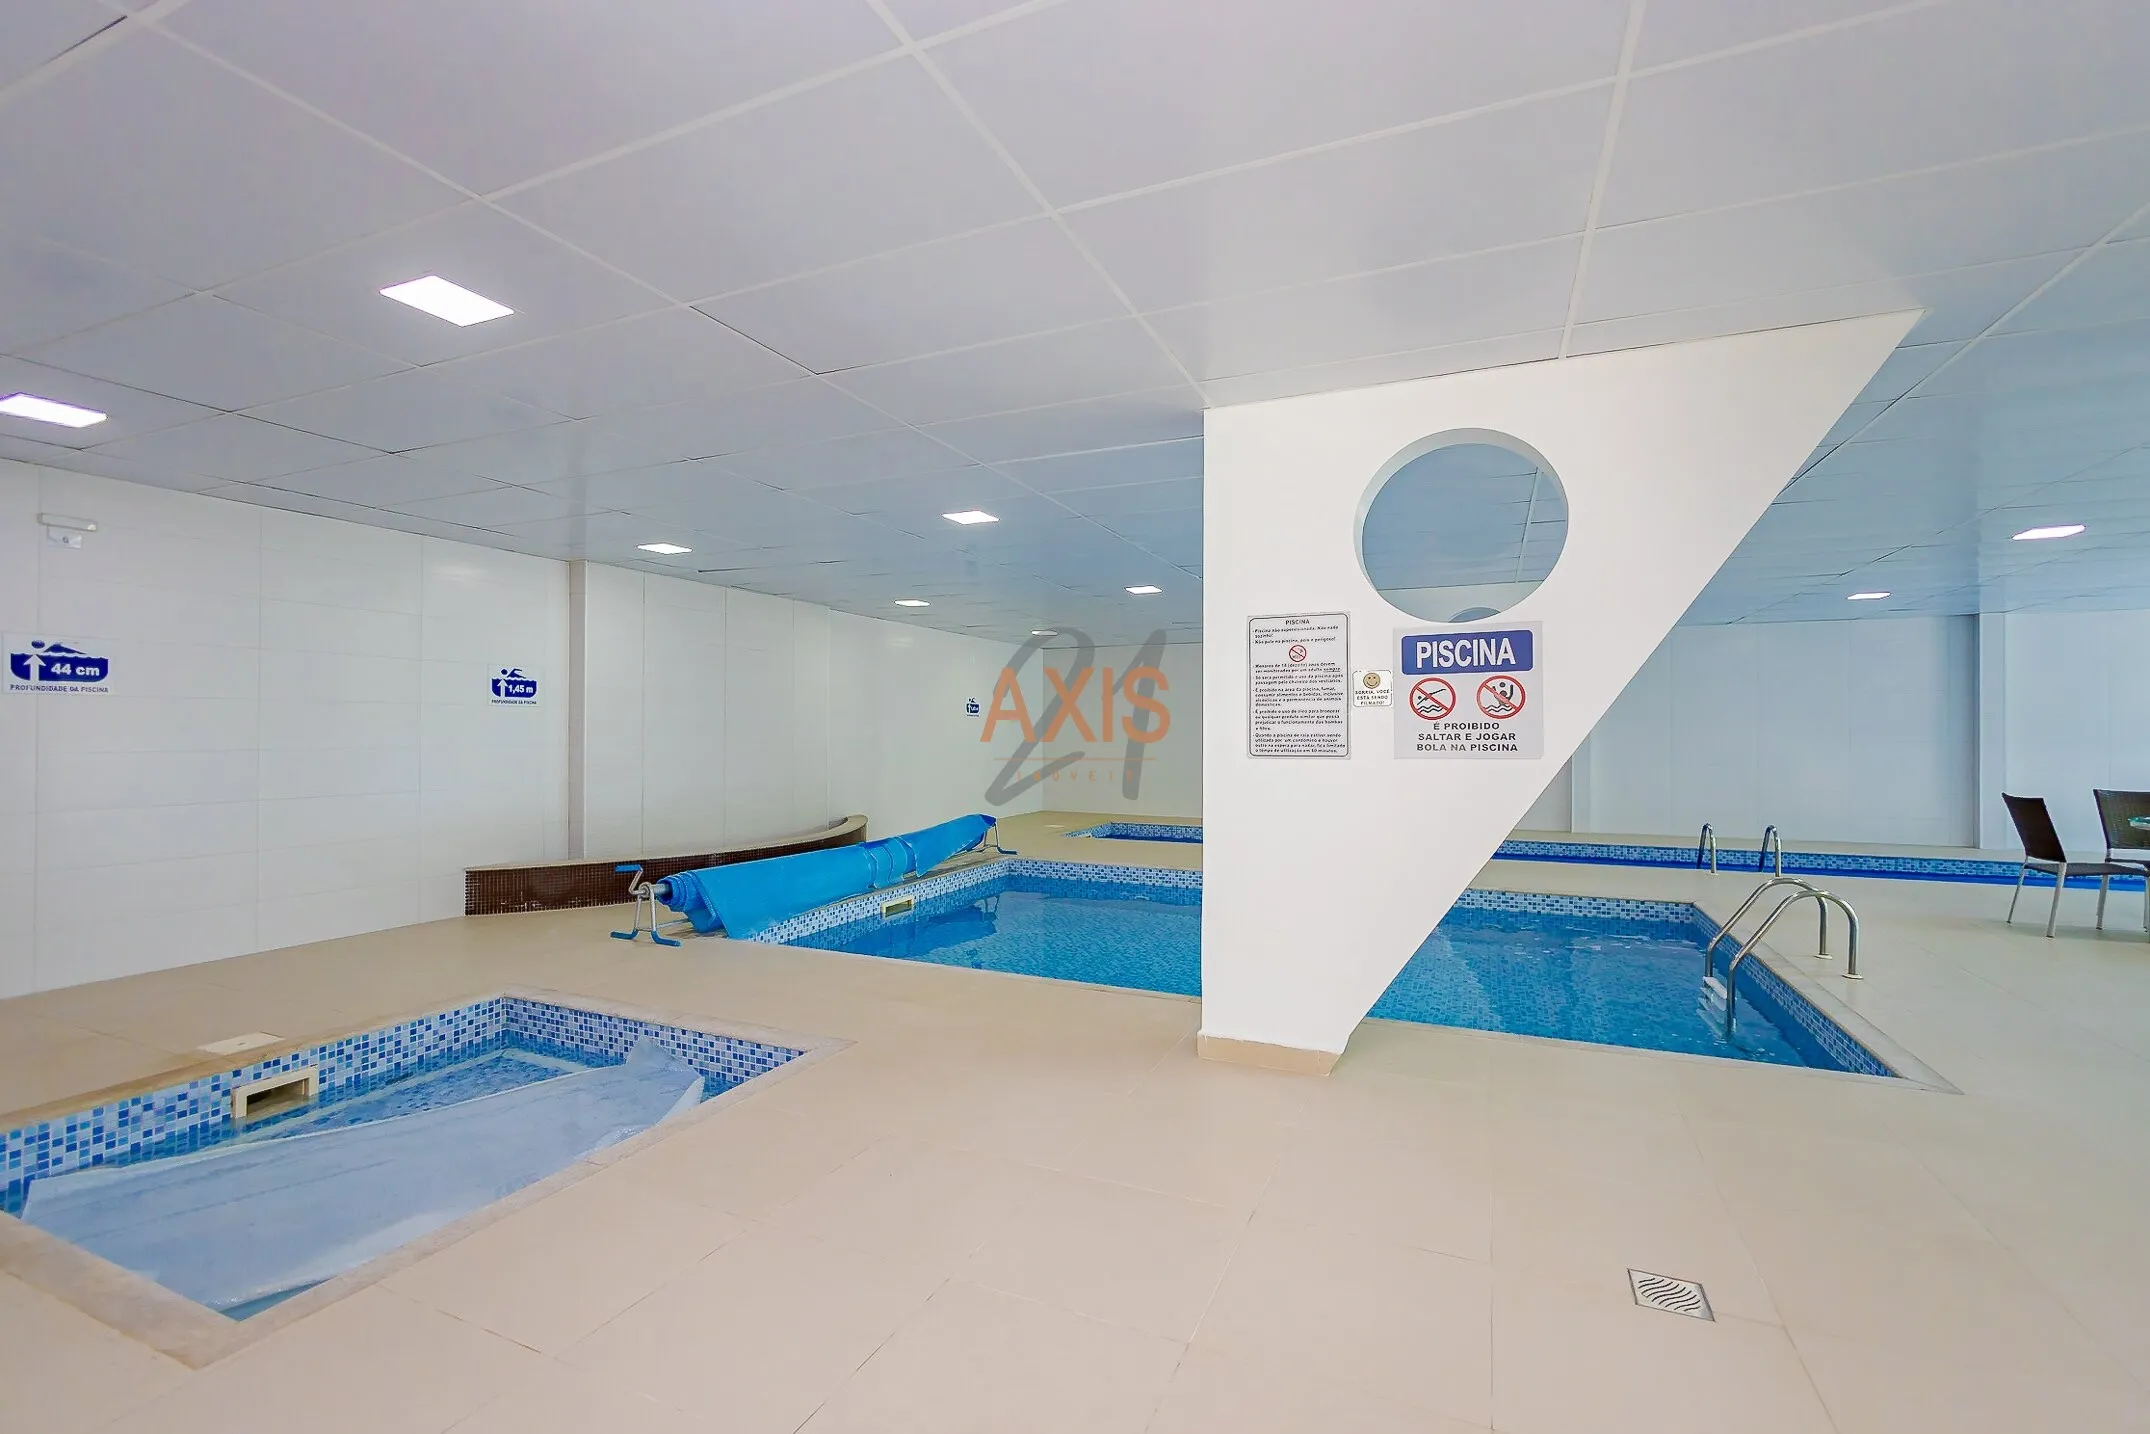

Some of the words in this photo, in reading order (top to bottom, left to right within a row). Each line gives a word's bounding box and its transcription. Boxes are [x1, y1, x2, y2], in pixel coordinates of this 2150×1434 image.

[1416, 638, 1516, 669] PISCINA
[51, 664, 71, 675] 44
[76, 666, 99, 676] cm
[508, 685, 524, 694] 1,45
[1433, 722, 1440, 730] É
